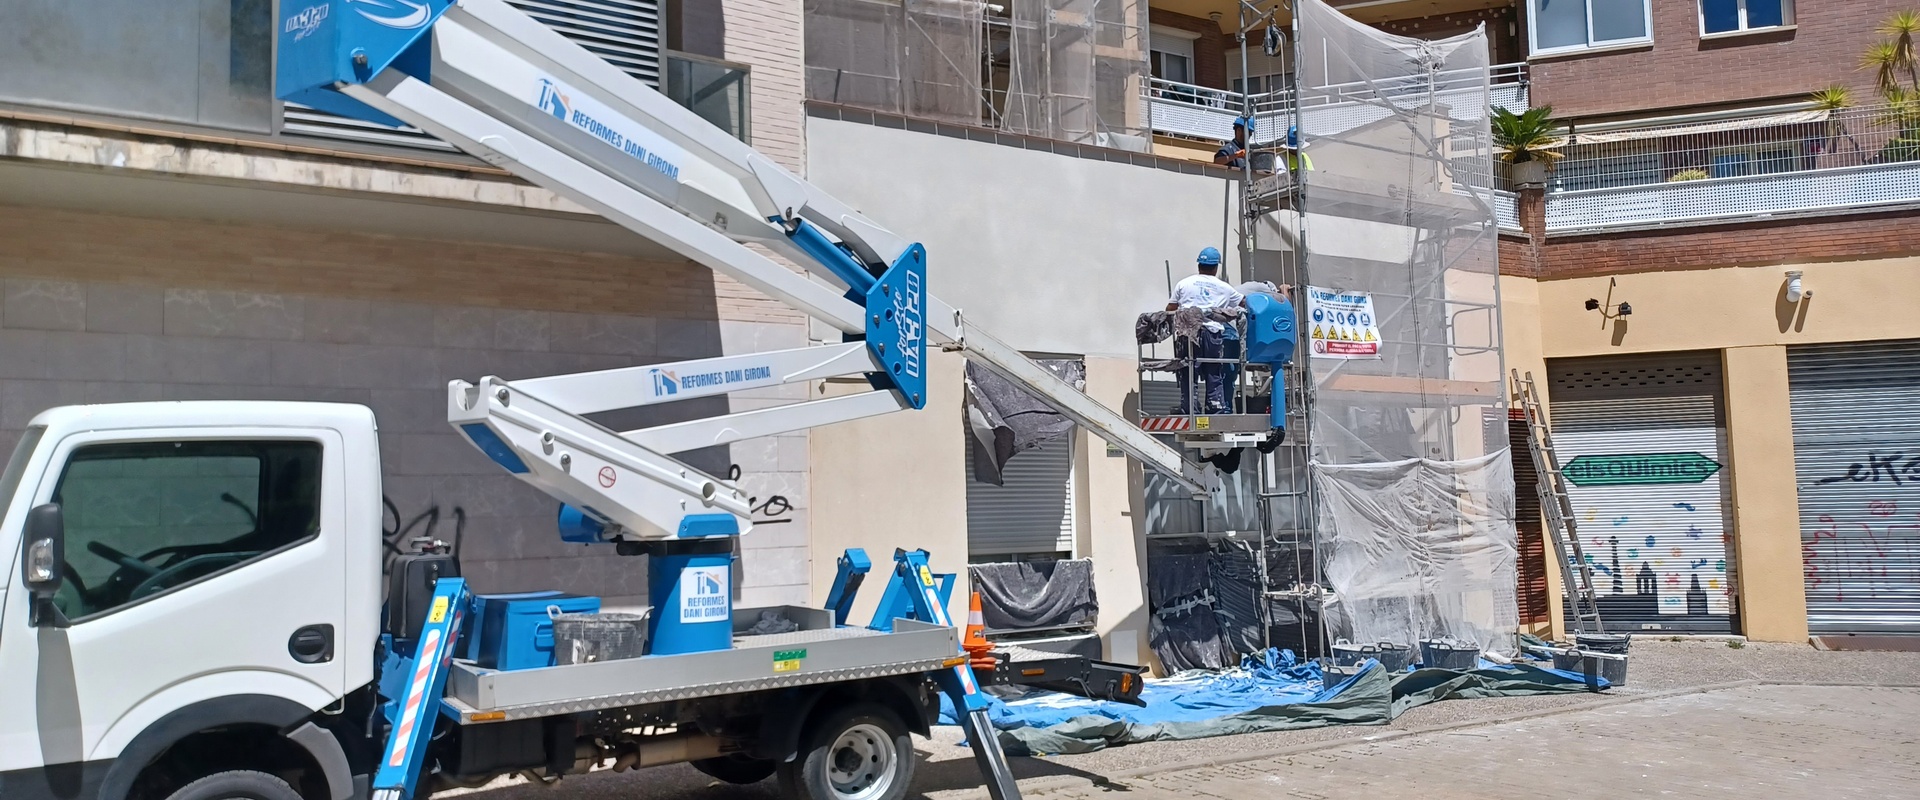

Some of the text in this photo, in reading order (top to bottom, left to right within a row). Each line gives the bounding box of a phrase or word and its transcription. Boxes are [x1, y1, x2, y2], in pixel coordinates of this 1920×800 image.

[572, 109, 680, 181] REFORMES DANI GIRONA
[681, 366, 771, 390] REFORMES DANI GIRONA
[687, 595, 725, 607] REFORMES
[684, 606, 727, 618] DANI GIRONA
